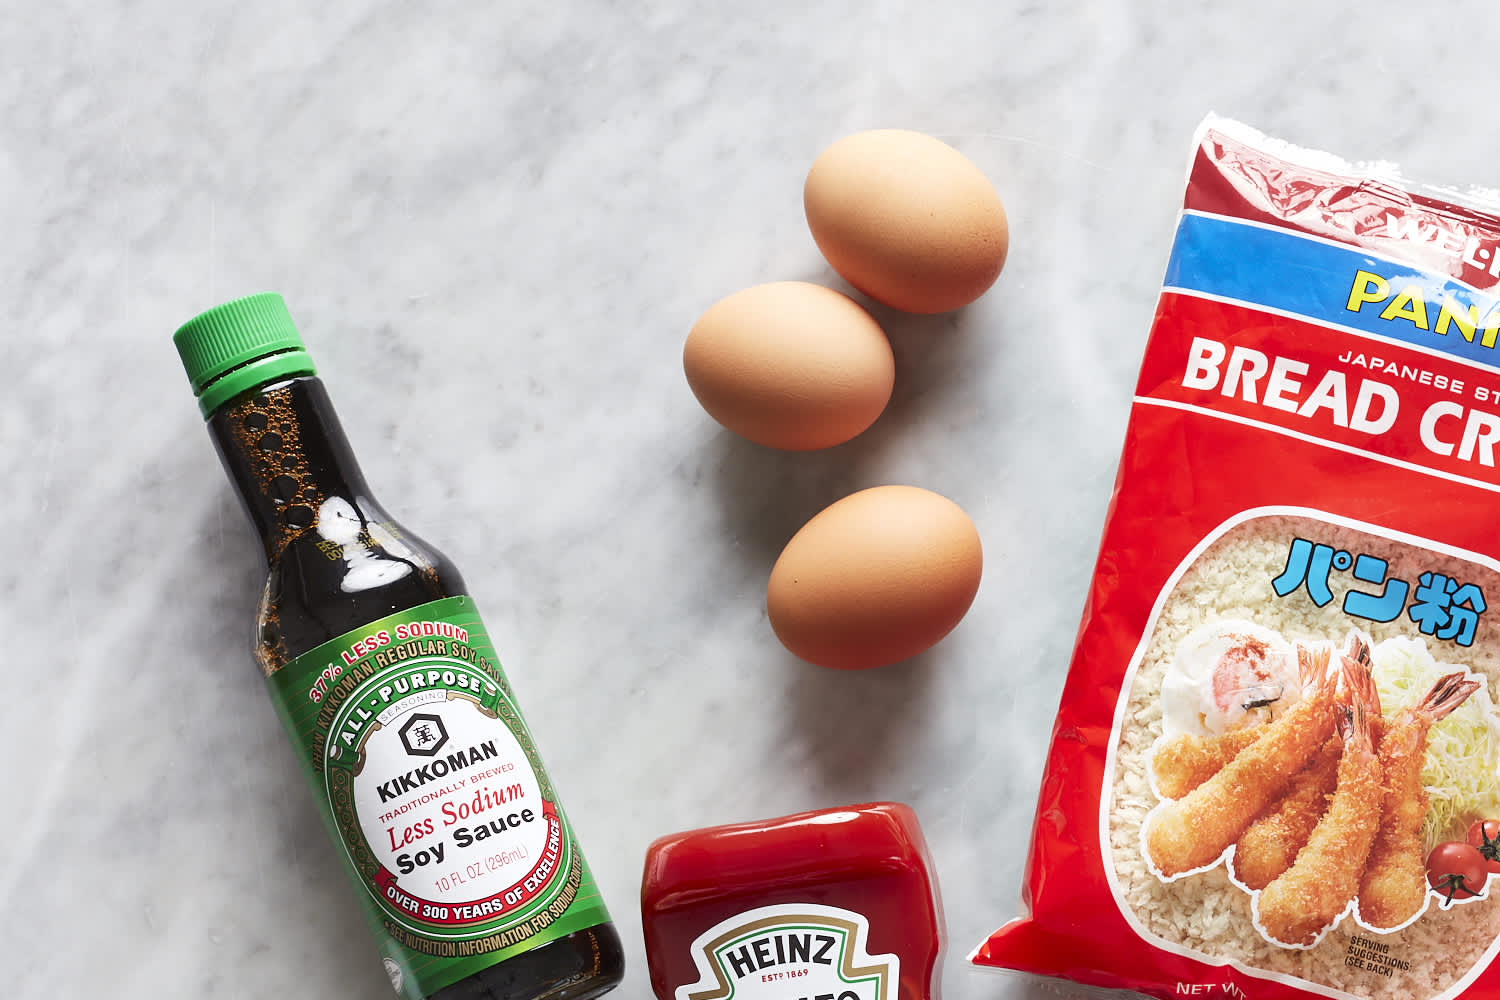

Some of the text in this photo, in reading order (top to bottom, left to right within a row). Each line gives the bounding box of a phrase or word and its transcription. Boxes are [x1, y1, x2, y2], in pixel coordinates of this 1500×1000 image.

[1182, 336, 1400, 434] BREAD
[1339, 350, 1464, 392] JAPANESE
[1271, 538, 1487, 647] パン粉
[309, 622, 469, 703] 37% LESS SODIUM
[317, 640, 476, 727] KIKKOMAN REGULAR SOY
[341, 670, 481, 746] ALL-PURPOSE
[380, 691, 445, 722] SEASONING
[377, 740, 498, 803] KIKKOMAN
[379, 763, 514, 823] TRADITIONALLY BREWED
[387, 783, 525, 852] Less Sodium
[396, 808, 535, 874] Soy Sauce
[386, 818, 560, 919] OVER 300 YEARS OF EXCELLENCE
[435, 845, 529, 893] 10 FL OZ (296mL)
[405, 907, 553, 957] NUTRITION INFORMATION FOR
[726, 934, 836, 979] HEINZ
[1351, 936, 1389, 955] SERVING
[786, 969, 808, 979] 1869
[1176, 981, 1216, 996] NET
